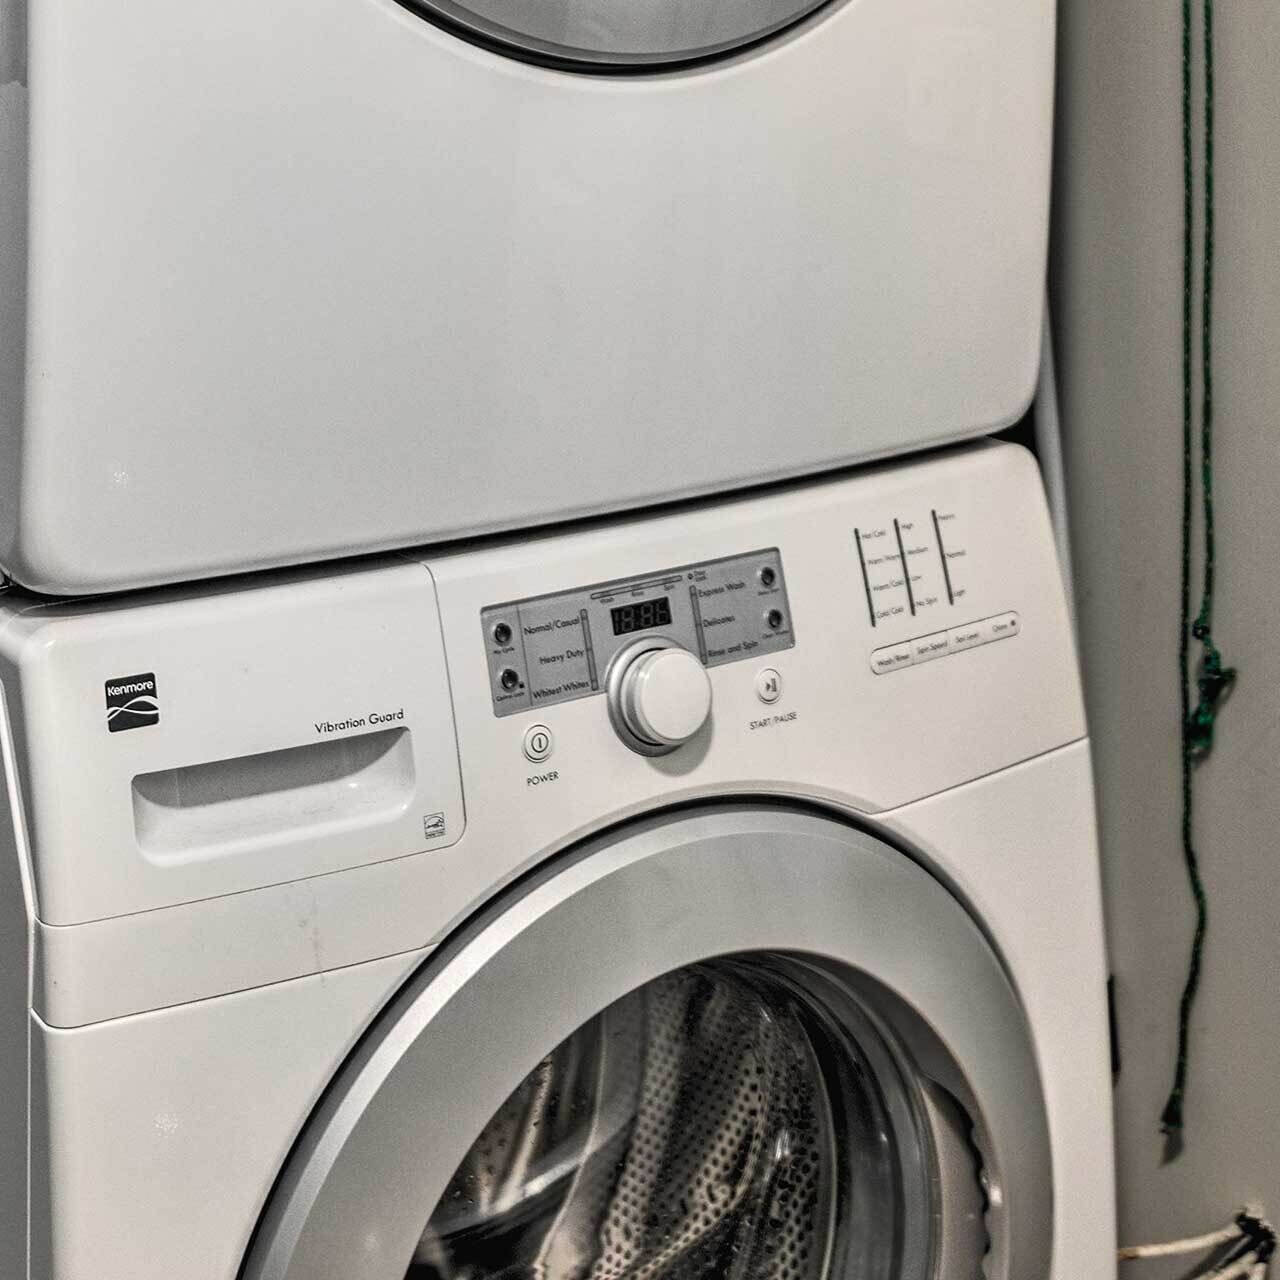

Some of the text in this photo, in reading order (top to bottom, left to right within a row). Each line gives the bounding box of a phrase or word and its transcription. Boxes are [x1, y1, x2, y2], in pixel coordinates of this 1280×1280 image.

[524, 616, 580, 635] Normal/Casual
[540, 649, 584, 665] Heavy Duty
[107, 678, 153, 698] Kenmore
[533, 681, 589, 699] Whitest Whites
[315, 708, 405, 735] Vibration Guard
[526, 770, 559, 787] POWER
